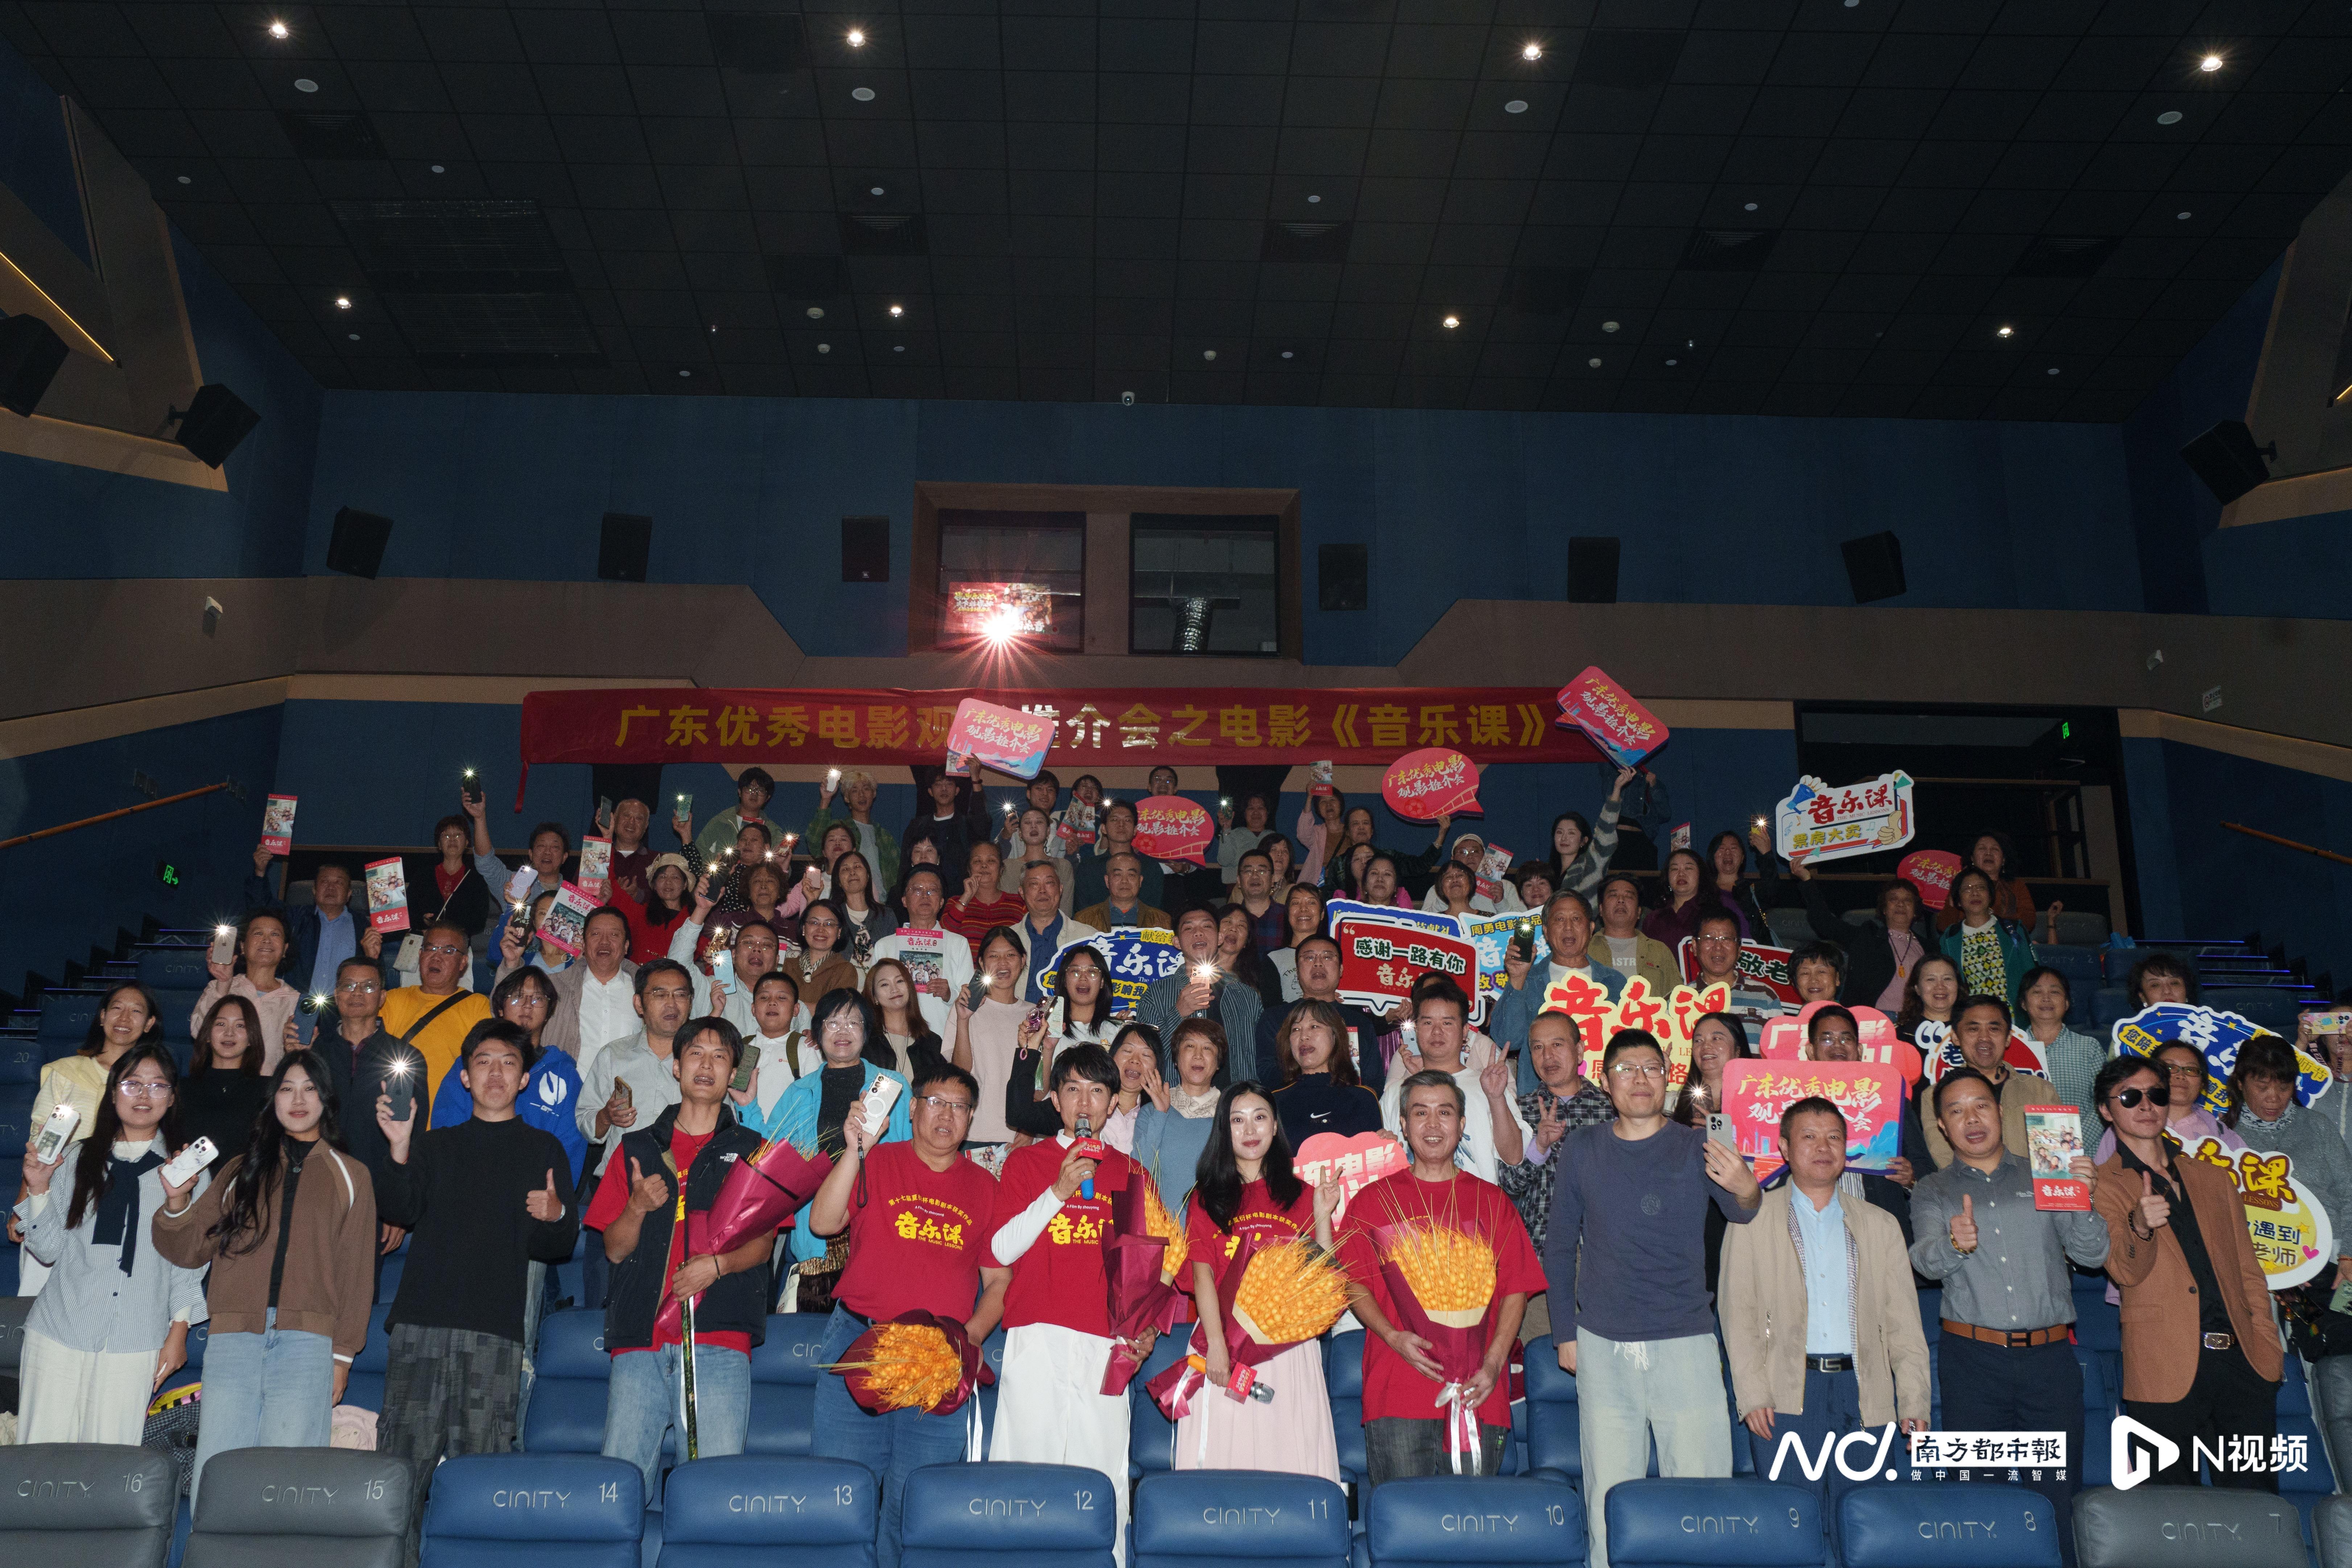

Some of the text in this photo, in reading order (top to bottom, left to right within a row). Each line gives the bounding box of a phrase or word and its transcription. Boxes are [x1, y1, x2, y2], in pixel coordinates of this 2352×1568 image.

[1580, 691, 1635, 746] 观影推介会
[1585, 678, 1655, 740] 广东优秀电影
[964, 708, 1043, 743] 广东优秀电影
[965, 725, 1031, 754] 观影推介会
[1388, 755, 1465, 787] 广东优秀电影
[1397, 774, 1464, 798] 观影推介会
[1138, 807, 1205, 826] 东优秀电影
[1808, 784, 1892, 824] 音乐课
[1137, 821, 1200, 837] 观影推介会
[1792, 824, 1861, 849] 票房大卖
[1355, 938, 1464, 973] 感谢一路有你
[1377, 963, 1417, 988] 音乐
[14, 1053, 29, 1062] 20
[1738, 1073, 1882, 1113] 广东优秀电影
[2042, 1184, 2076, 1197] 音乐课
[2244, 1195, 2279, 1209] LESSONS
[895, 1210, 964, 1245] 音乐课
[945, 1242, 962, 1250] LESSONS
[17, 1472, 143, 1499] CINITY 16
[261, 1479, 384, 1504] CINITY 15
[493, 1481, 619, 1509] CINITY 14
[729, 1484, 853, 1513] CINITY 13
[969, 1490, 1093, 1517] CINITY 12
[1203, 1498, 1328, 1525] CINITY 11
[1442, 1505, 1564, 1532] CINITY 10
[1680, 1507, 1800, 1534] CINITY 9
[1918, 1510, 2037, 1539] CINITY 8
[2162, 1513, 2281, 1541] CINITY 7
